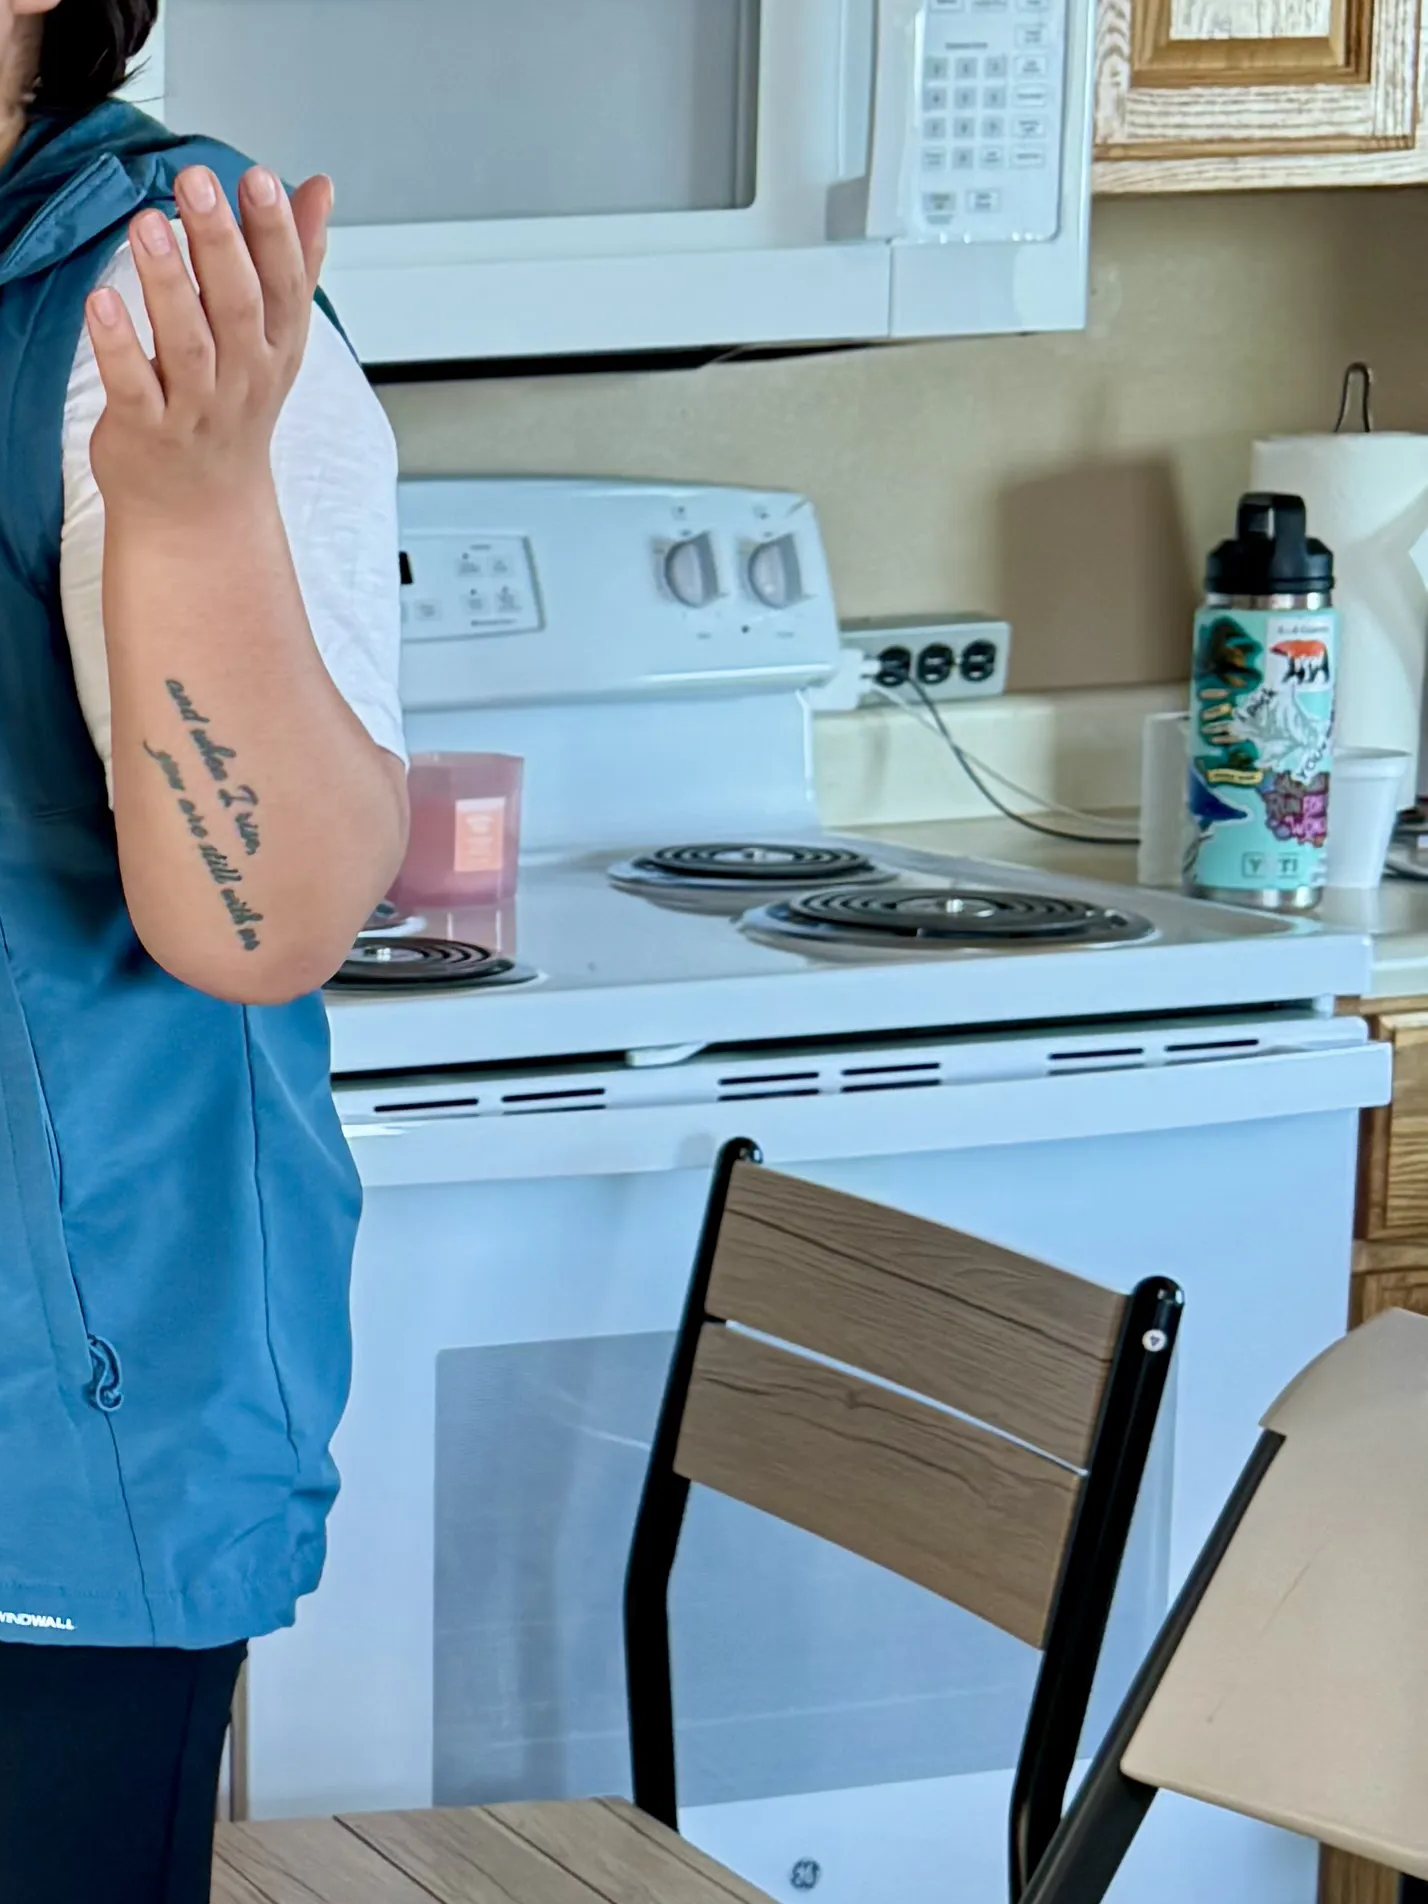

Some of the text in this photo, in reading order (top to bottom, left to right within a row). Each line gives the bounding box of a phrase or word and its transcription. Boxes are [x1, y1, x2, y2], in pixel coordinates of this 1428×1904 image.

[165, 678, 210, 724] and
[190, 728, 237, 782] when
[217, 784, 259, 809] I
[197, 842, 243, 885] still
[1248, 857, 1298, 873] YTI
